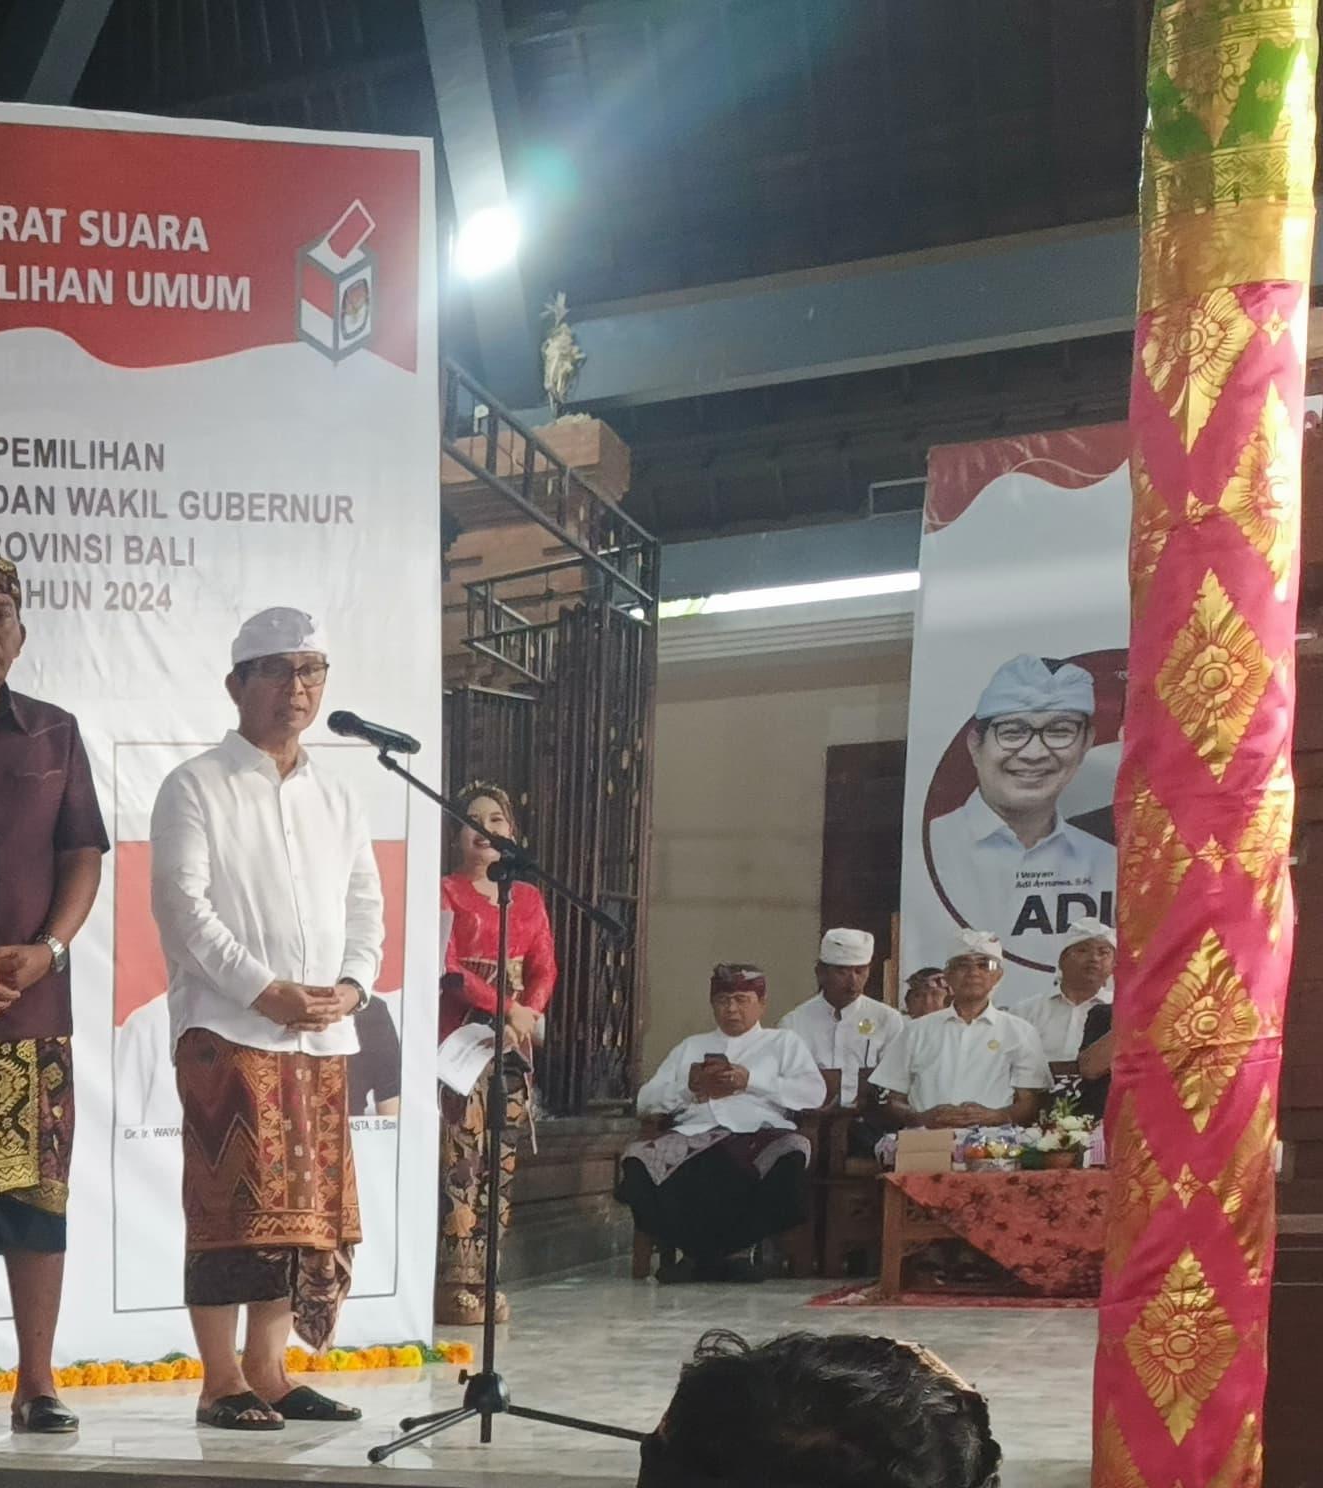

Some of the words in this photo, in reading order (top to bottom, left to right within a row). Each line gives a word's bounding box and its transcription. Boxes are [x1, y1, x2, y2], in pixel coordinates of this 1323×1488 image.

[79, 209, 209, 253] SUARA
[126, 270, 252, 313] UMUM
[66, 486, 169, 520] WAKIL
[179, 490, 355, 525] GUBERNUR
[123, 534, 195, 567] BALI
[104, 580, 173, 612] 2024
